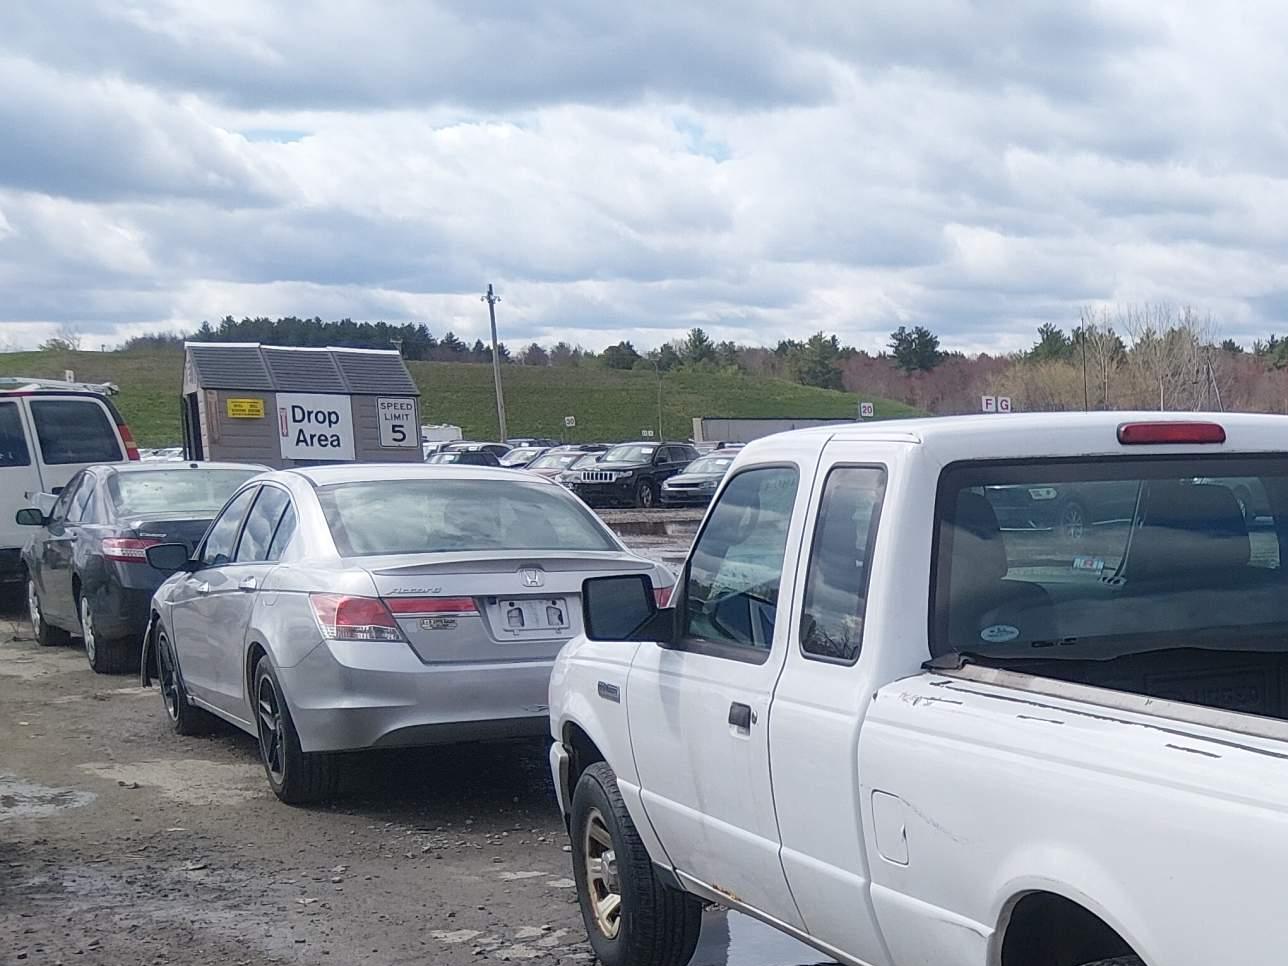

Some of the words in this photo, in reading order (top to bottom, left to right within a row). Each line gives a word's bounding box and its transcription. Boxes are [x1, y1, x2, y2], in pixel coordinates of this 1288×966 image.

[379, 402, 413, 411] SPEED
[862, 405, 873, 414] 20
[985, 399, 993, 410] F
[1000, 399, 1010, 411] G
[291, 405, 340, 427] Drop
[384, 413, 410, 422] LIMIT
[295, 428, 341, 448] Area
[391, 424, 407, 443] 5
